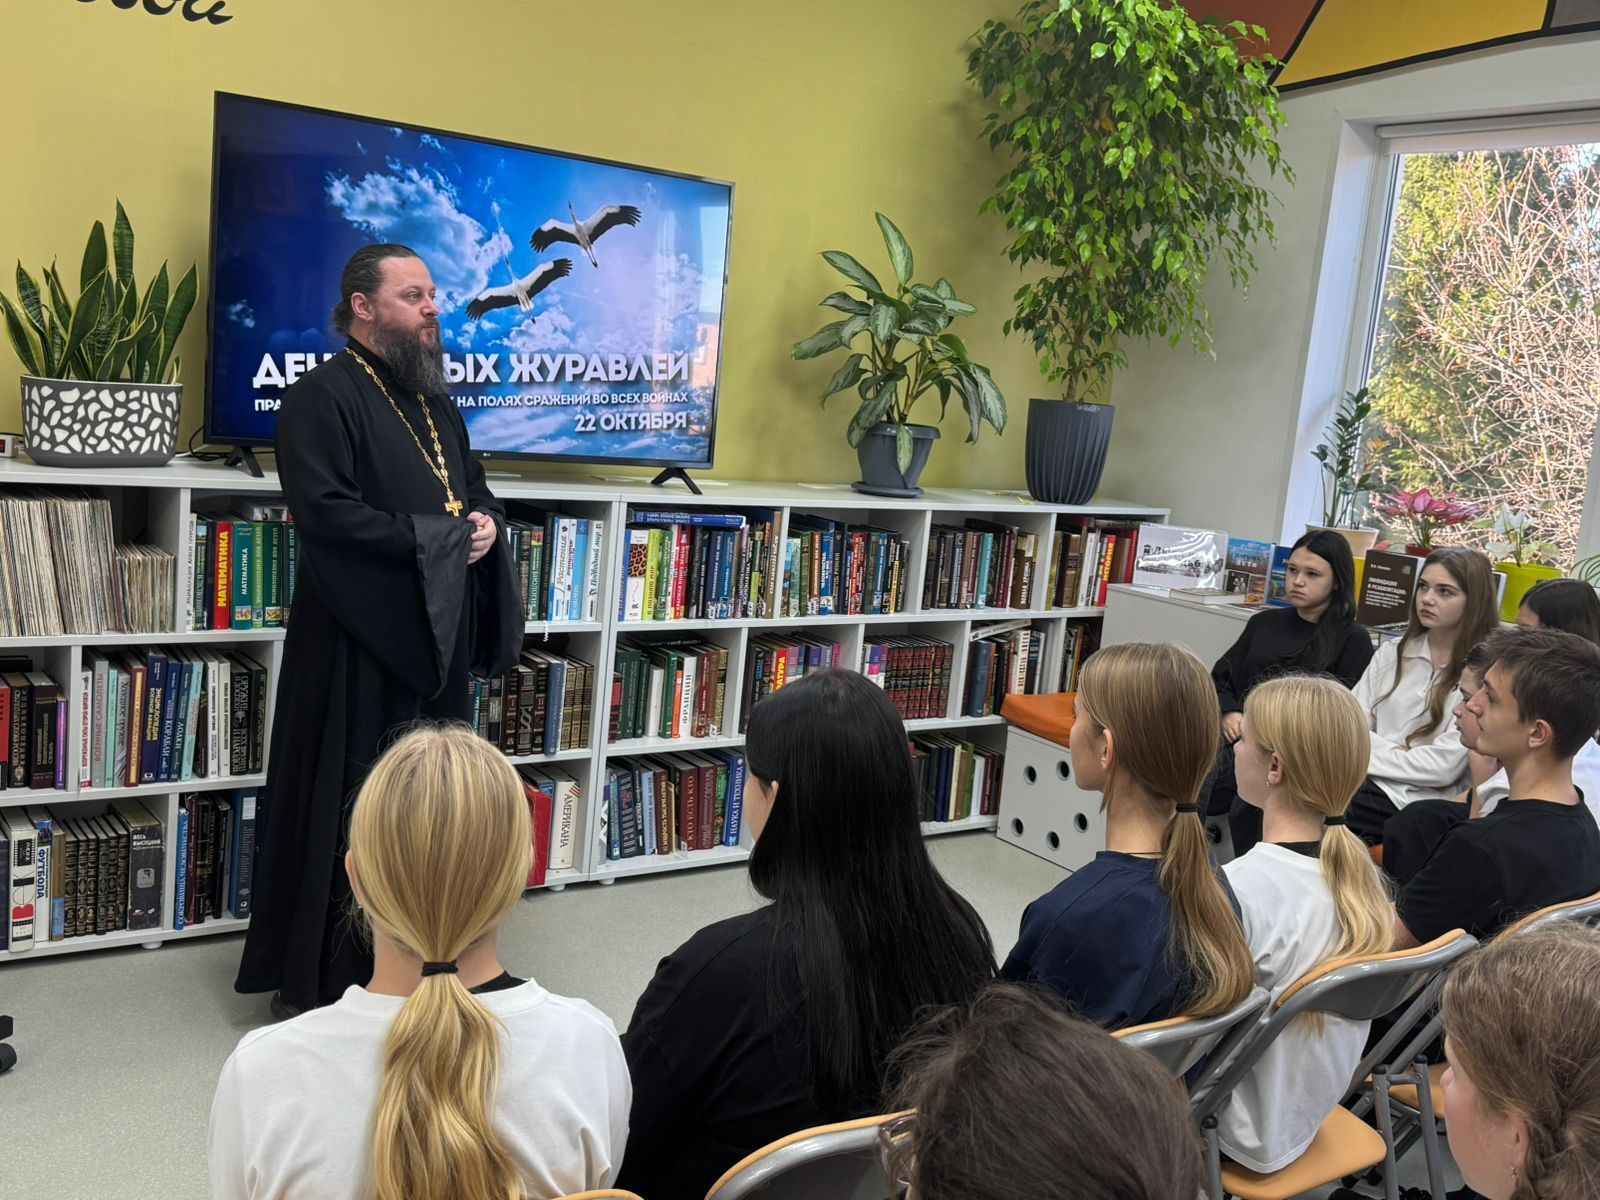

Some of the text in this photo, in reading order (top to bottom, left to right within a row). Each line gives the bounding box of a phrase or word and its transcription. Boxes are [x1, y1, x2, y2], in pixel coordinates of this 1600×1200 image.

[442, 352, 501, 383] ЫХ
[508, 350, 689, 383] ЖУРАВЛЕЙ
[457, 396, 476, 407] НА
[478, 395, 522, 407] ПОЛЯХ
[524, 392, 591, 406] СРАЖЕНИЙ
[593, 394, 609, 404] ВО
[611, 392, 641, 404] ВСЕХ
[643, 391, 688, 403] ВОЙНАХ
[574, 411, 687, 432] 22 ОКТЯБРЯ
[218, 531, 228, 607] МАТЕМАТИКА
[556, 535, 568, 585] Растения
[590, 532, 602, 586] Подводный мир
[1102, 543, 1114, 581] ИСТОРИЯ
[95, 673, 103, 720] САМОЛЕТЫ
[118, 681, 129, 747] Холодное оружие
[152, 688, 162, 741] ЭНЦИКЛОПЕДИЯ
[240, 676, 249, 711] ОРУЖИЕ
[682, 674, 691, 724] ФРАНЦИЯ
[162, 720, 172, 757] КОРАБЛИ
[175, 722, 184, 749] ЛОДКИ
[232, 736, 241, 773] НАРОДОВ
[734, 766, 743, 800] ТЕХНИКА
[560, 793, 572, 848] АМЕРИКАНА
[730, 810, 739, 834] НАУКА
[37, 849, 45, 899] ФУТБОЛА
[177, 820, 188, 924] СОКРОВИЩА ЧЕЛОВЕЧЕСТВА
